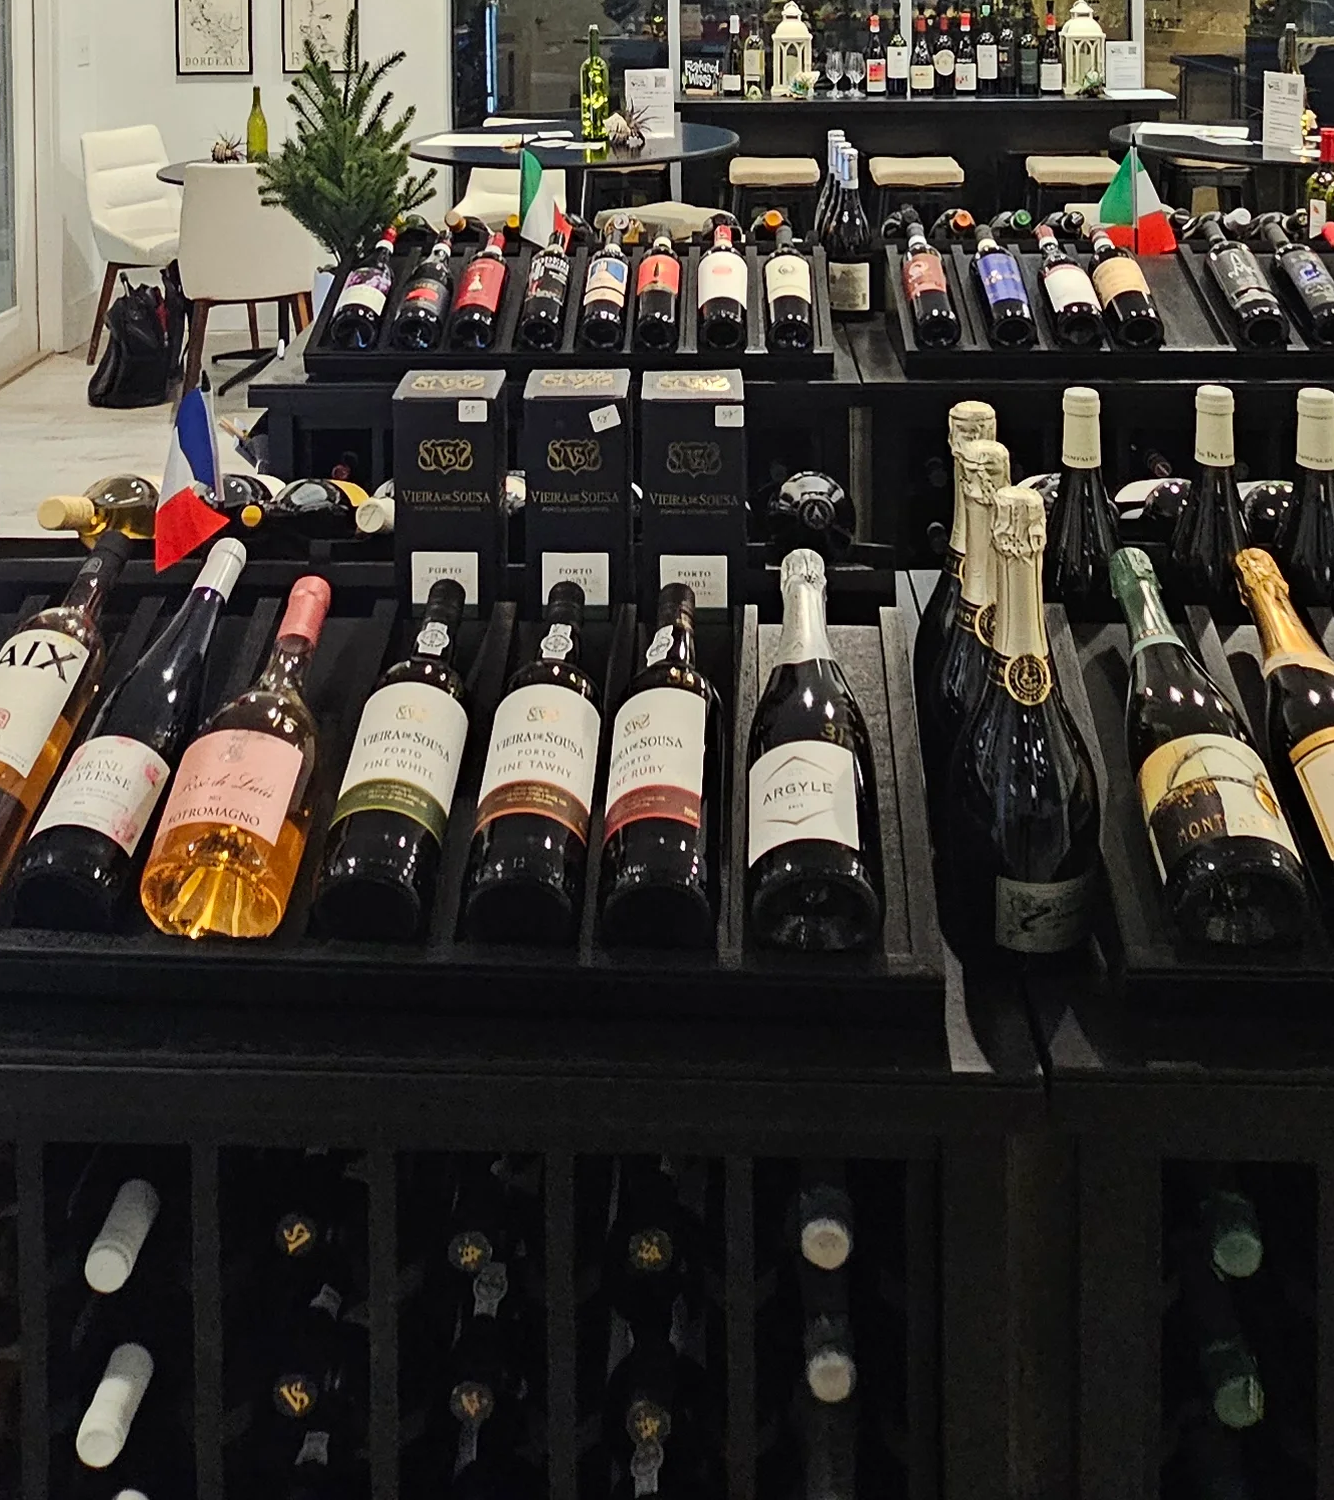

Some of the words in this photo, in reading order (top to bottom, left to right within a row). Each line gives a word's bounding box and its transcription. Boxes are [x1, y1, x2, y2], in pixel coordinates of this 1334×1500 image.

[184, 56, 246, 67] BORDEAUX
[402, 490, 440, 504] VIEIRA
[452, 490, 491, 504] SOUSA
[531, 490, 570, 504] VIEIRA
[581, 490, 619, 504] SOUSA
[649, 492, 688, 507] VIEIRA
[699, 493, 739, 507] SOUSA
[428, 566, 463, 575] PORTO
[558, 567, 593, 576] PORTO
[677, 570, 712, 579] PORTO
[362, 729, 400, 748] VIEIRA
[412, 731, 451, 764] SOUSA
[495, 729, 532, 753] VIEIRA
[544, 730, 585, 760] SOUSA
[639, 735, 684, 750] SOUSA
[383, 746, 423, 760] PORTO
[517, 748, 556, 759] PORTO
[363, 757, 391, 772] FINE
[396, 760, 435, 781] WHITE
[497, 760, 522, 776] FINE
[528, 760, 572, 779] TAWNY
[631, 764, 666, 781] RUBY
[763, 780, 834, 806] ARGYLE
